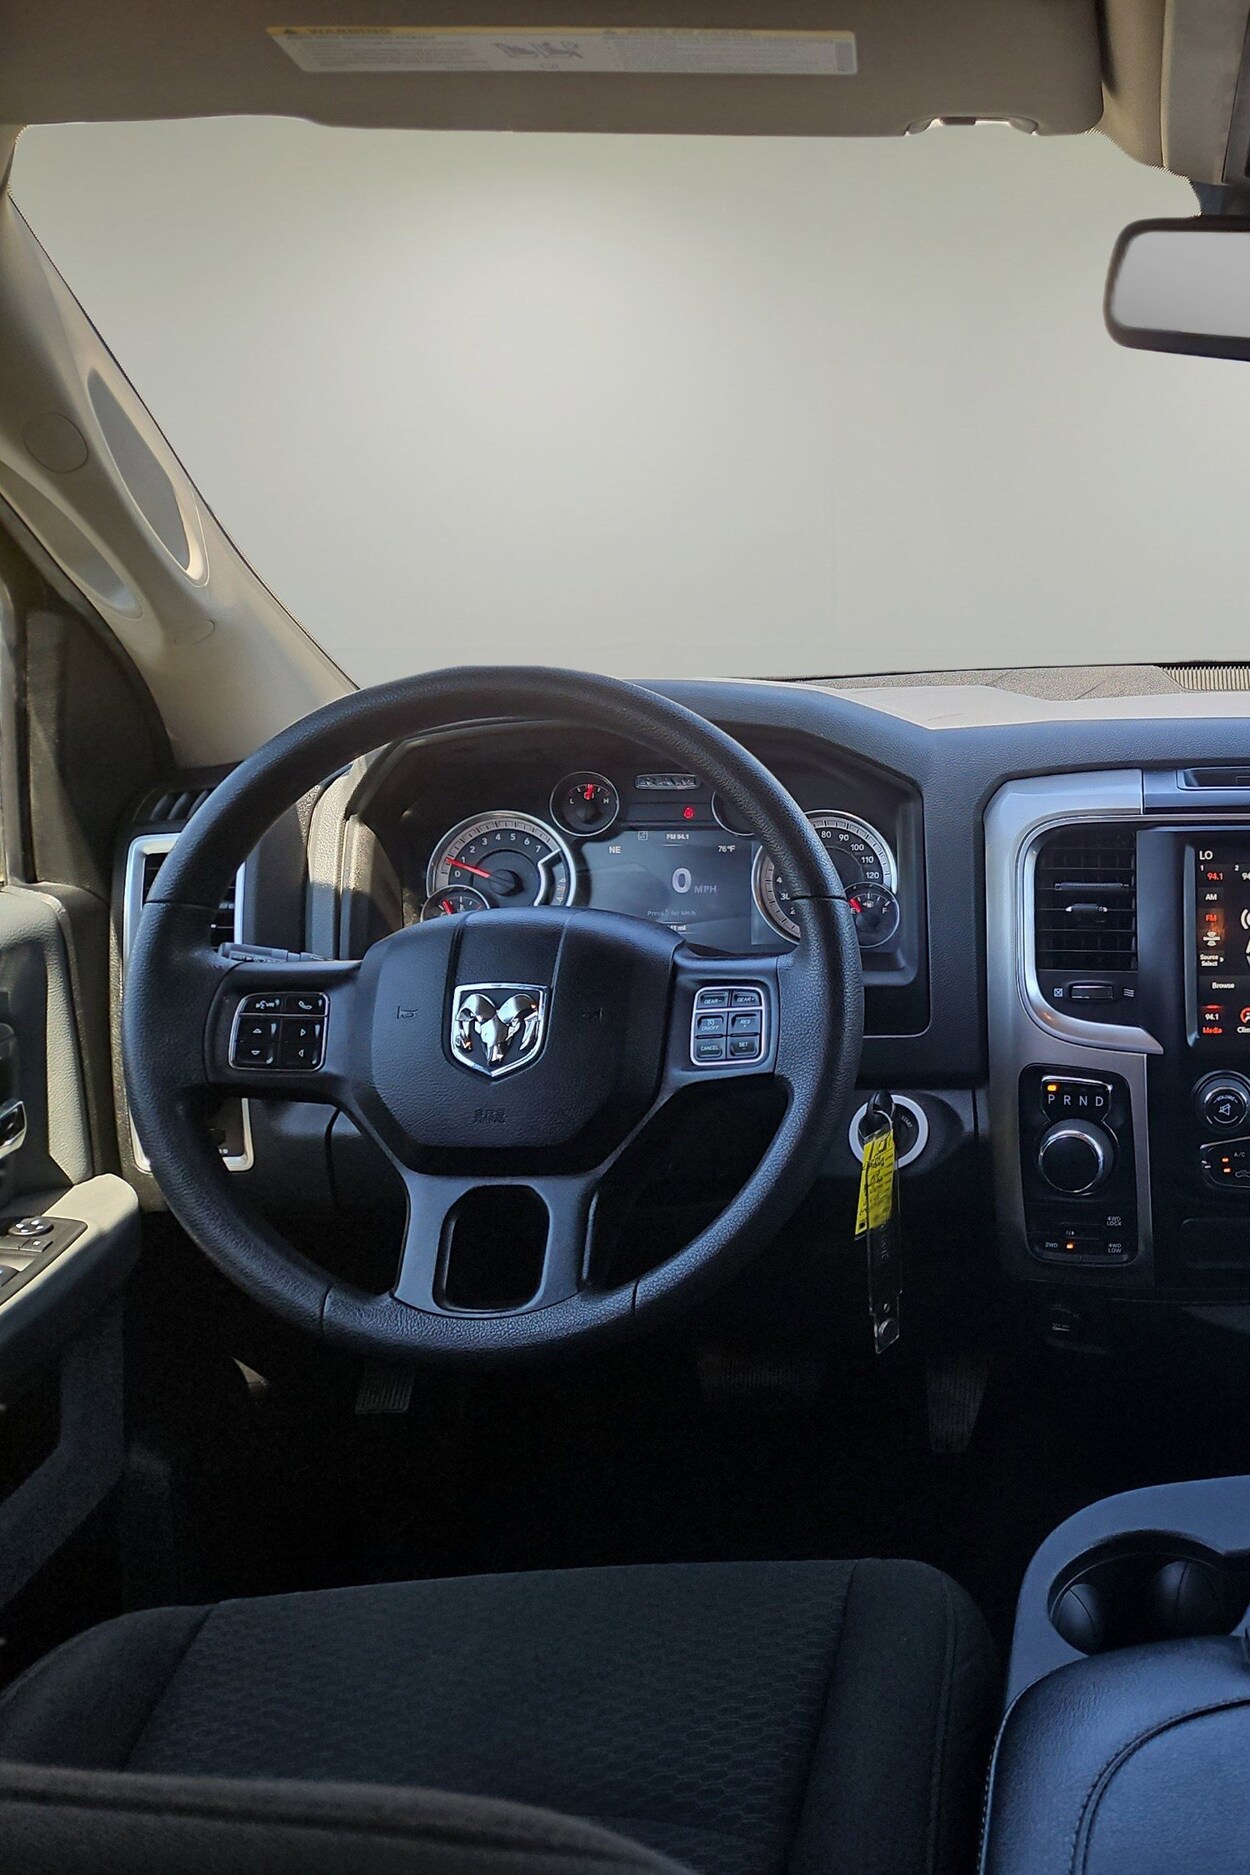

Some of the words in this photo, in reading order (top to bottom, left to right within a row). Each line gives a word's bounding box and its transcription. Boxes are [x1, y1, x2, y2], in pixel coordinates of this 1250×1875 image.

[495, 833, 502, 841] 4
[510, 833, 516, 841] 5
[821, 831, 832, 839] 80
[481, 838, 488, 846] 3
[524, 838, 530, 846] 6
[535, 845, 542, 853] 7
[609, 846, 622, 854] NE
[850, 843, 865, 851] 100
[1199, 850, 1214, 860] LO
[861, 856, 874, 864] 110
[454, 870, 461, 878] 0
[865, 871, 880, 879] 120
[1207, 872, 1224, 880] 94.1
[672, 867, 692, 894] 0
[694, 885, 717, 893] MPH
[1205, 893, 1218, 901] AM
[1204, 1013, 1219, 1021] 94.1
[1202, 1026, 1222, 1034] Media
[1047, 1094, 1056, 1105] P
[1063, 1095, 1072, 1106] R
[1079, 1095, 1088, 1106] N
[1095, 1096, 1104, 1107] D
